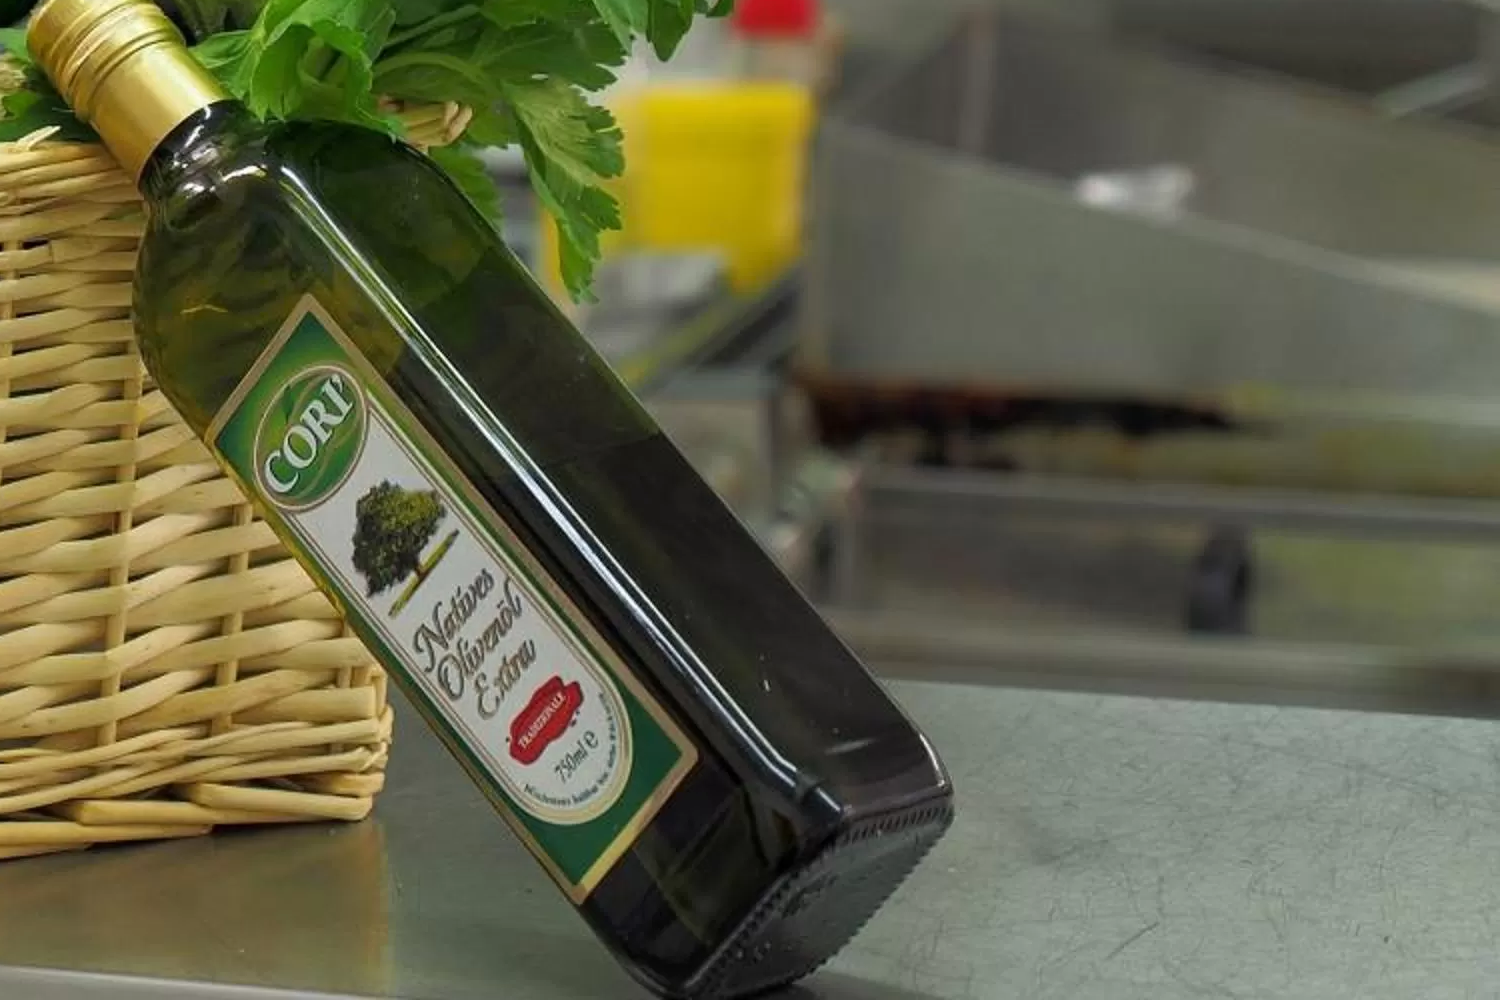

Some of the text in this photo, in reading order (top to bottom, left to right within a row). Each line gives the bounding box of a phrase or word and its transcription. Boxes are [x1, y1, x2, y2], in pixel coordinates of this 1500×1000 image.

[412, 567, 495, 673] Natives
[437, 575, 523, 701] Olivenöl
[473, 638, 537, 721] Extra
[553, 740, 589, 784] 750ml
